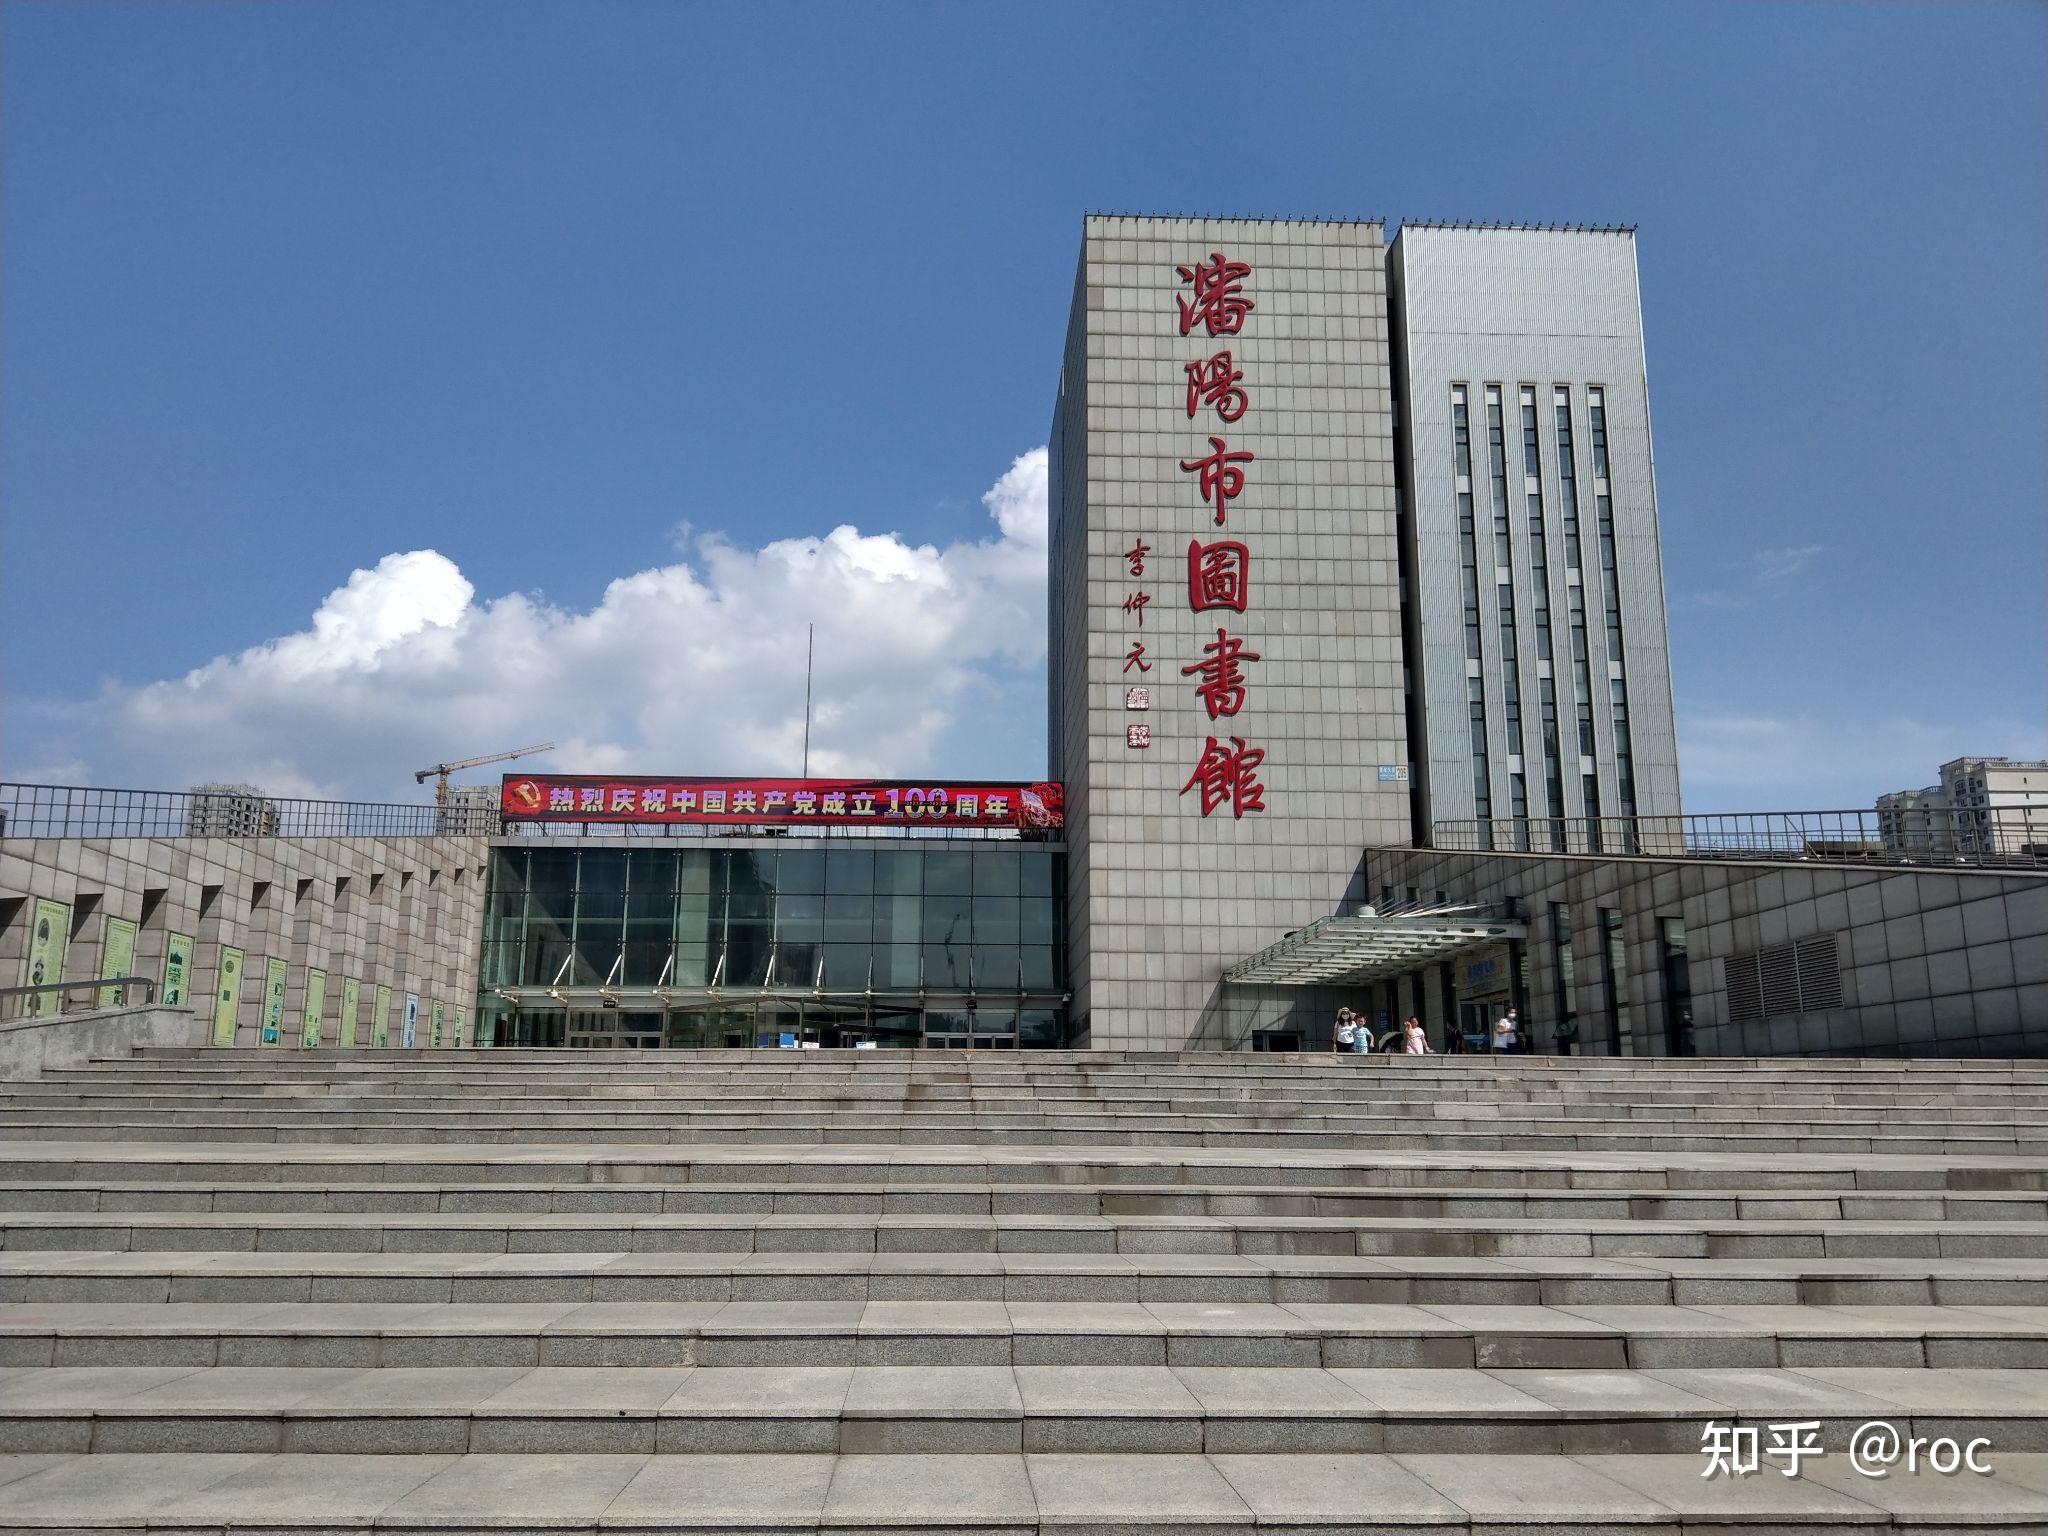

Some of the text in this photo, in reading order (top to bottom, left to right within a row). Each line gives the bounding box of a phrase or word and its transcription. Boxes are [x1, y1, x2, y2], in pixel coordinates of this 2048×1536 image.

[1176, 252, 1266, 819] 瀋陽市圖書館
[550, 787, 1009, 820] 热烈庆祝中国共产党成立100周年
